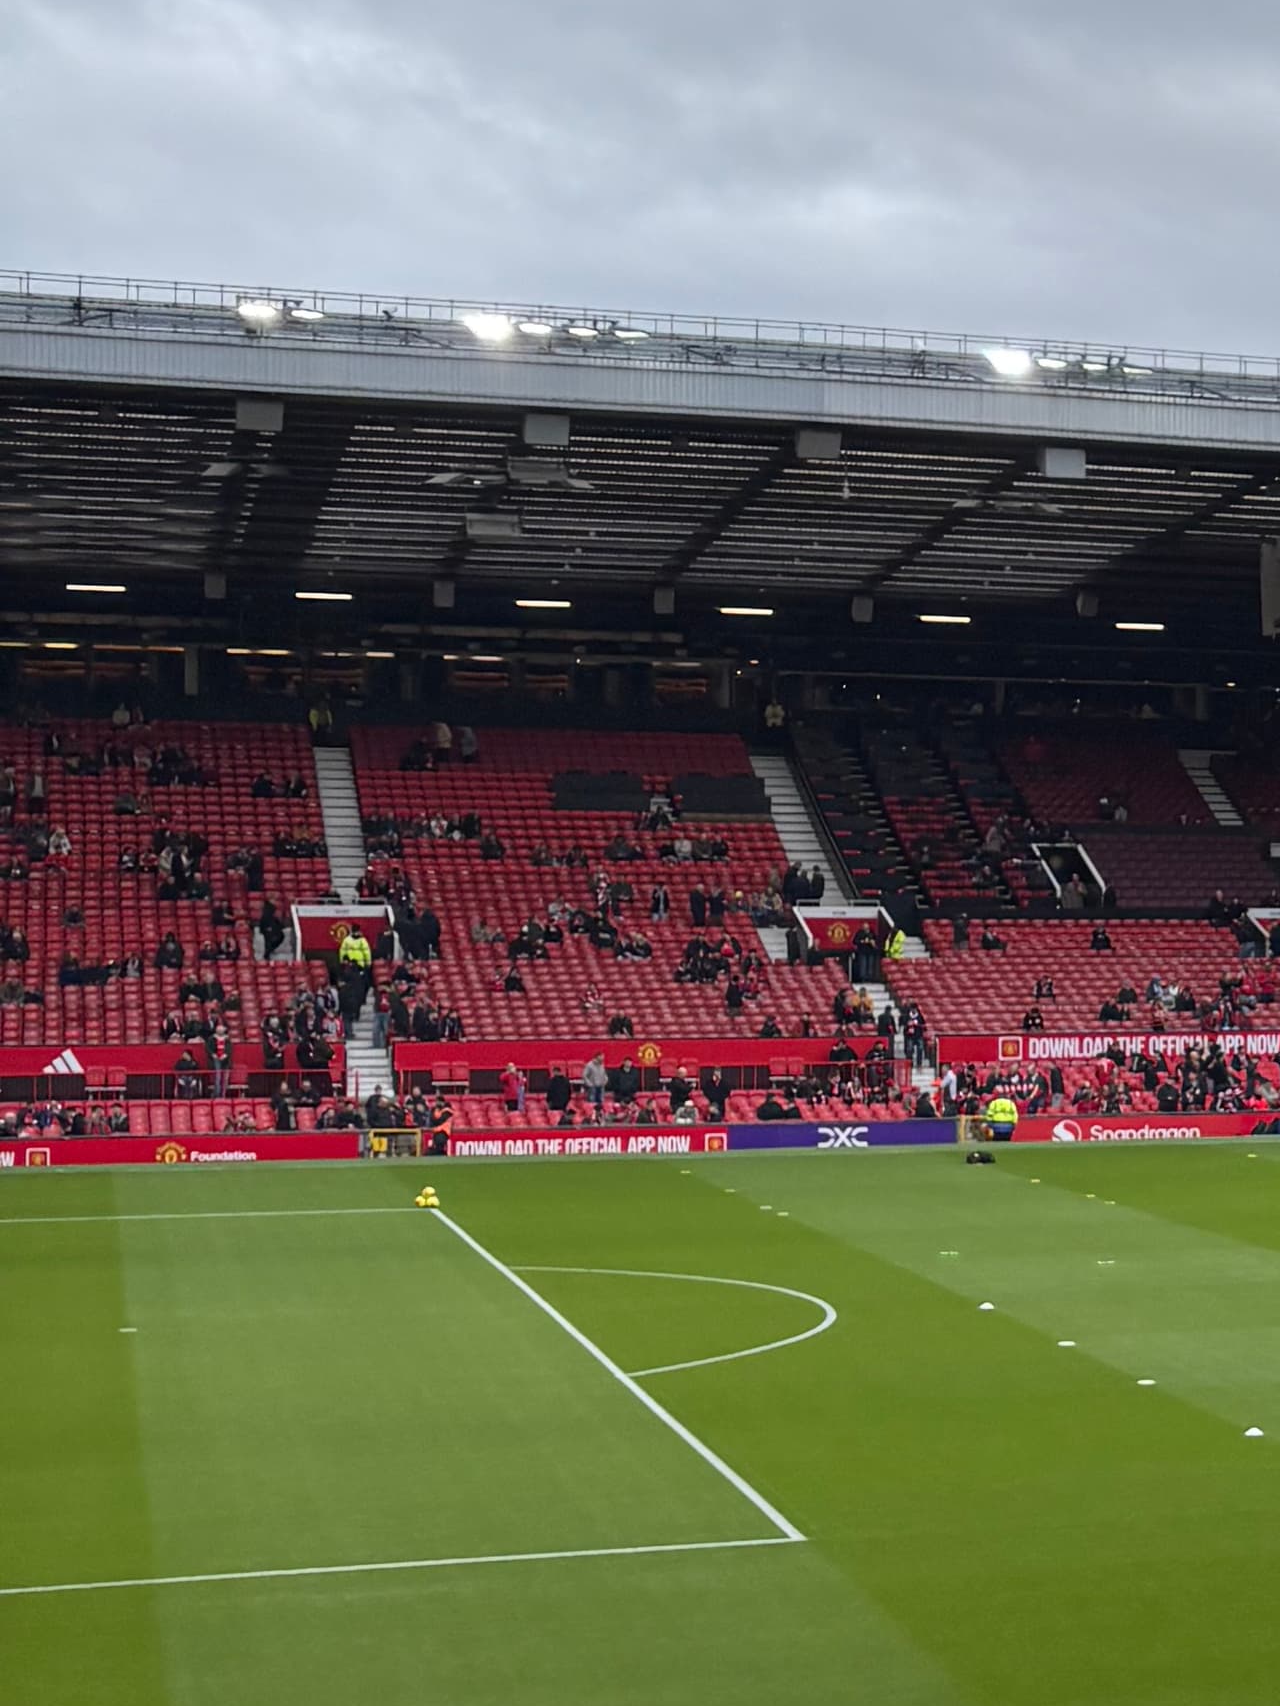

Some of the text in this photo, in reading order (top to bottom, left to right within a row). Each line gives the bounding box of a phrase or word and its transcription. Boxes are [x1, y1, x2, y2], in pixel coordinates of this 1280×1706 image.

[1246, 1034, 1280, 1055] NOW
[1090, 1124, 1201, 1142] Snapdragon
[456, 1134, 691, 1155] DOWNLOAD THE OFFICIAL APP NOW
[190, 1150, 257, 1162] Foundation
